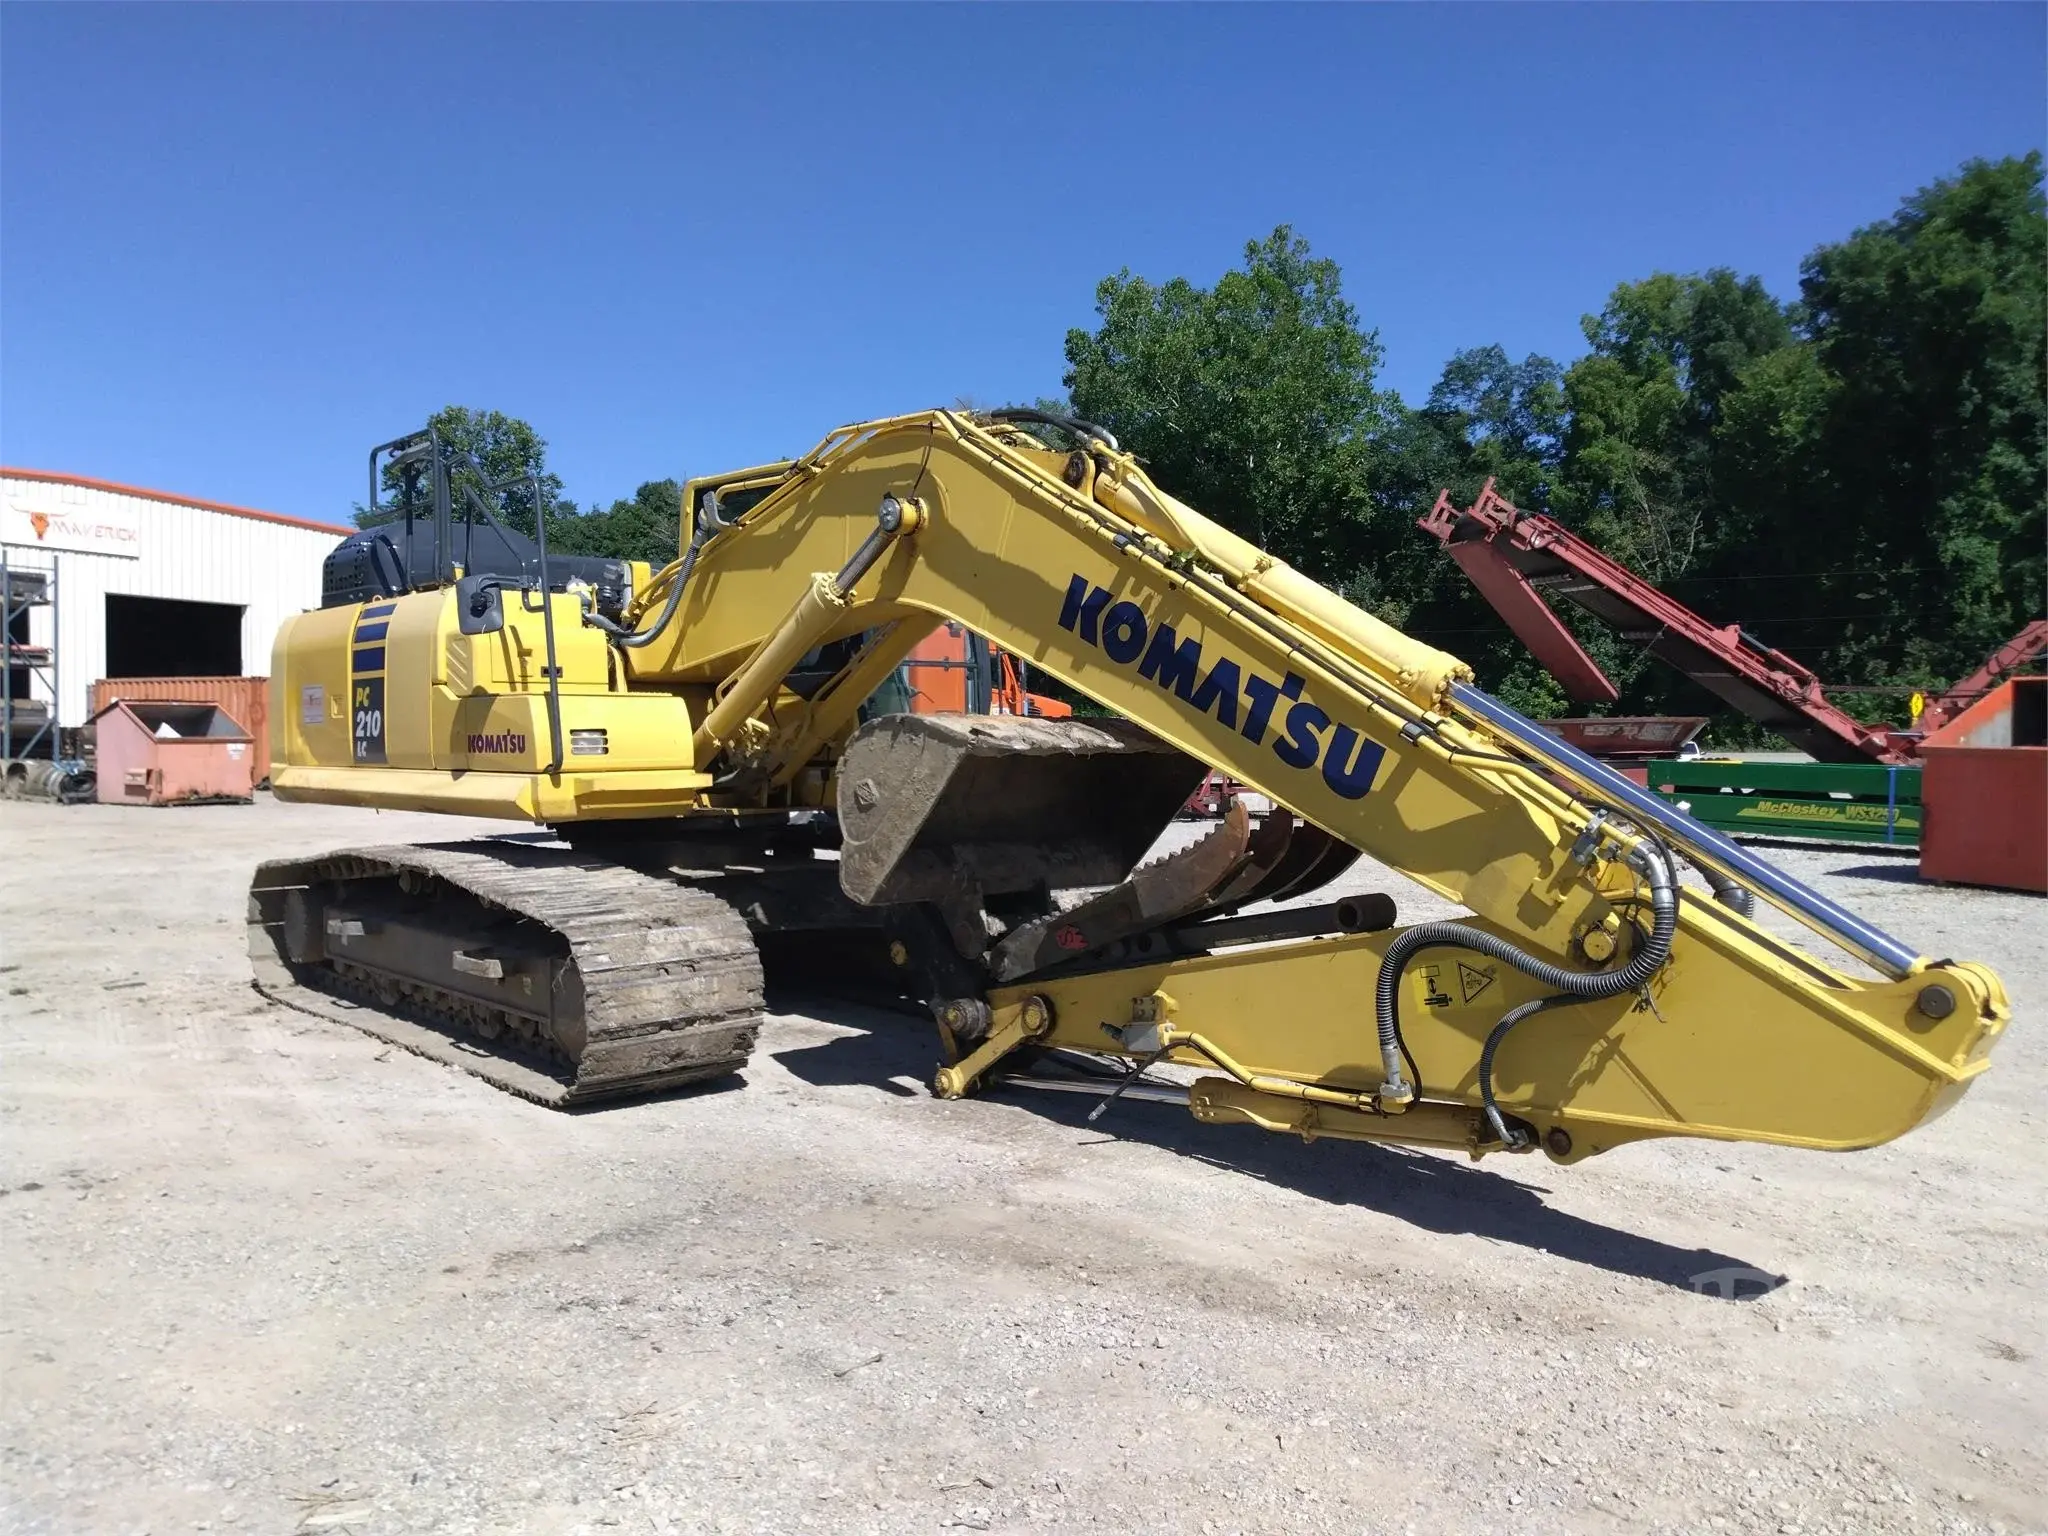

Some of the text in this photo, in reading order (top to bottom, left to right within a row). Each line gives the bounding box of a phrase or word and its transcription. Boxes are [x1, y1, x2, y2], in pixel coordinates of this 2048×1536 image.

[52, 519, 137, 542] MAVERICK
[355, 686, 371, 707] PC
[1058, 573, 1387, 800] KOMATSU
[355, 710, 382, 738] 210
[356, 741, 368, 757] LC
[467, 728, 526, 754] KOMATSU
[1757, 801, 1838, 819] McCloskey
